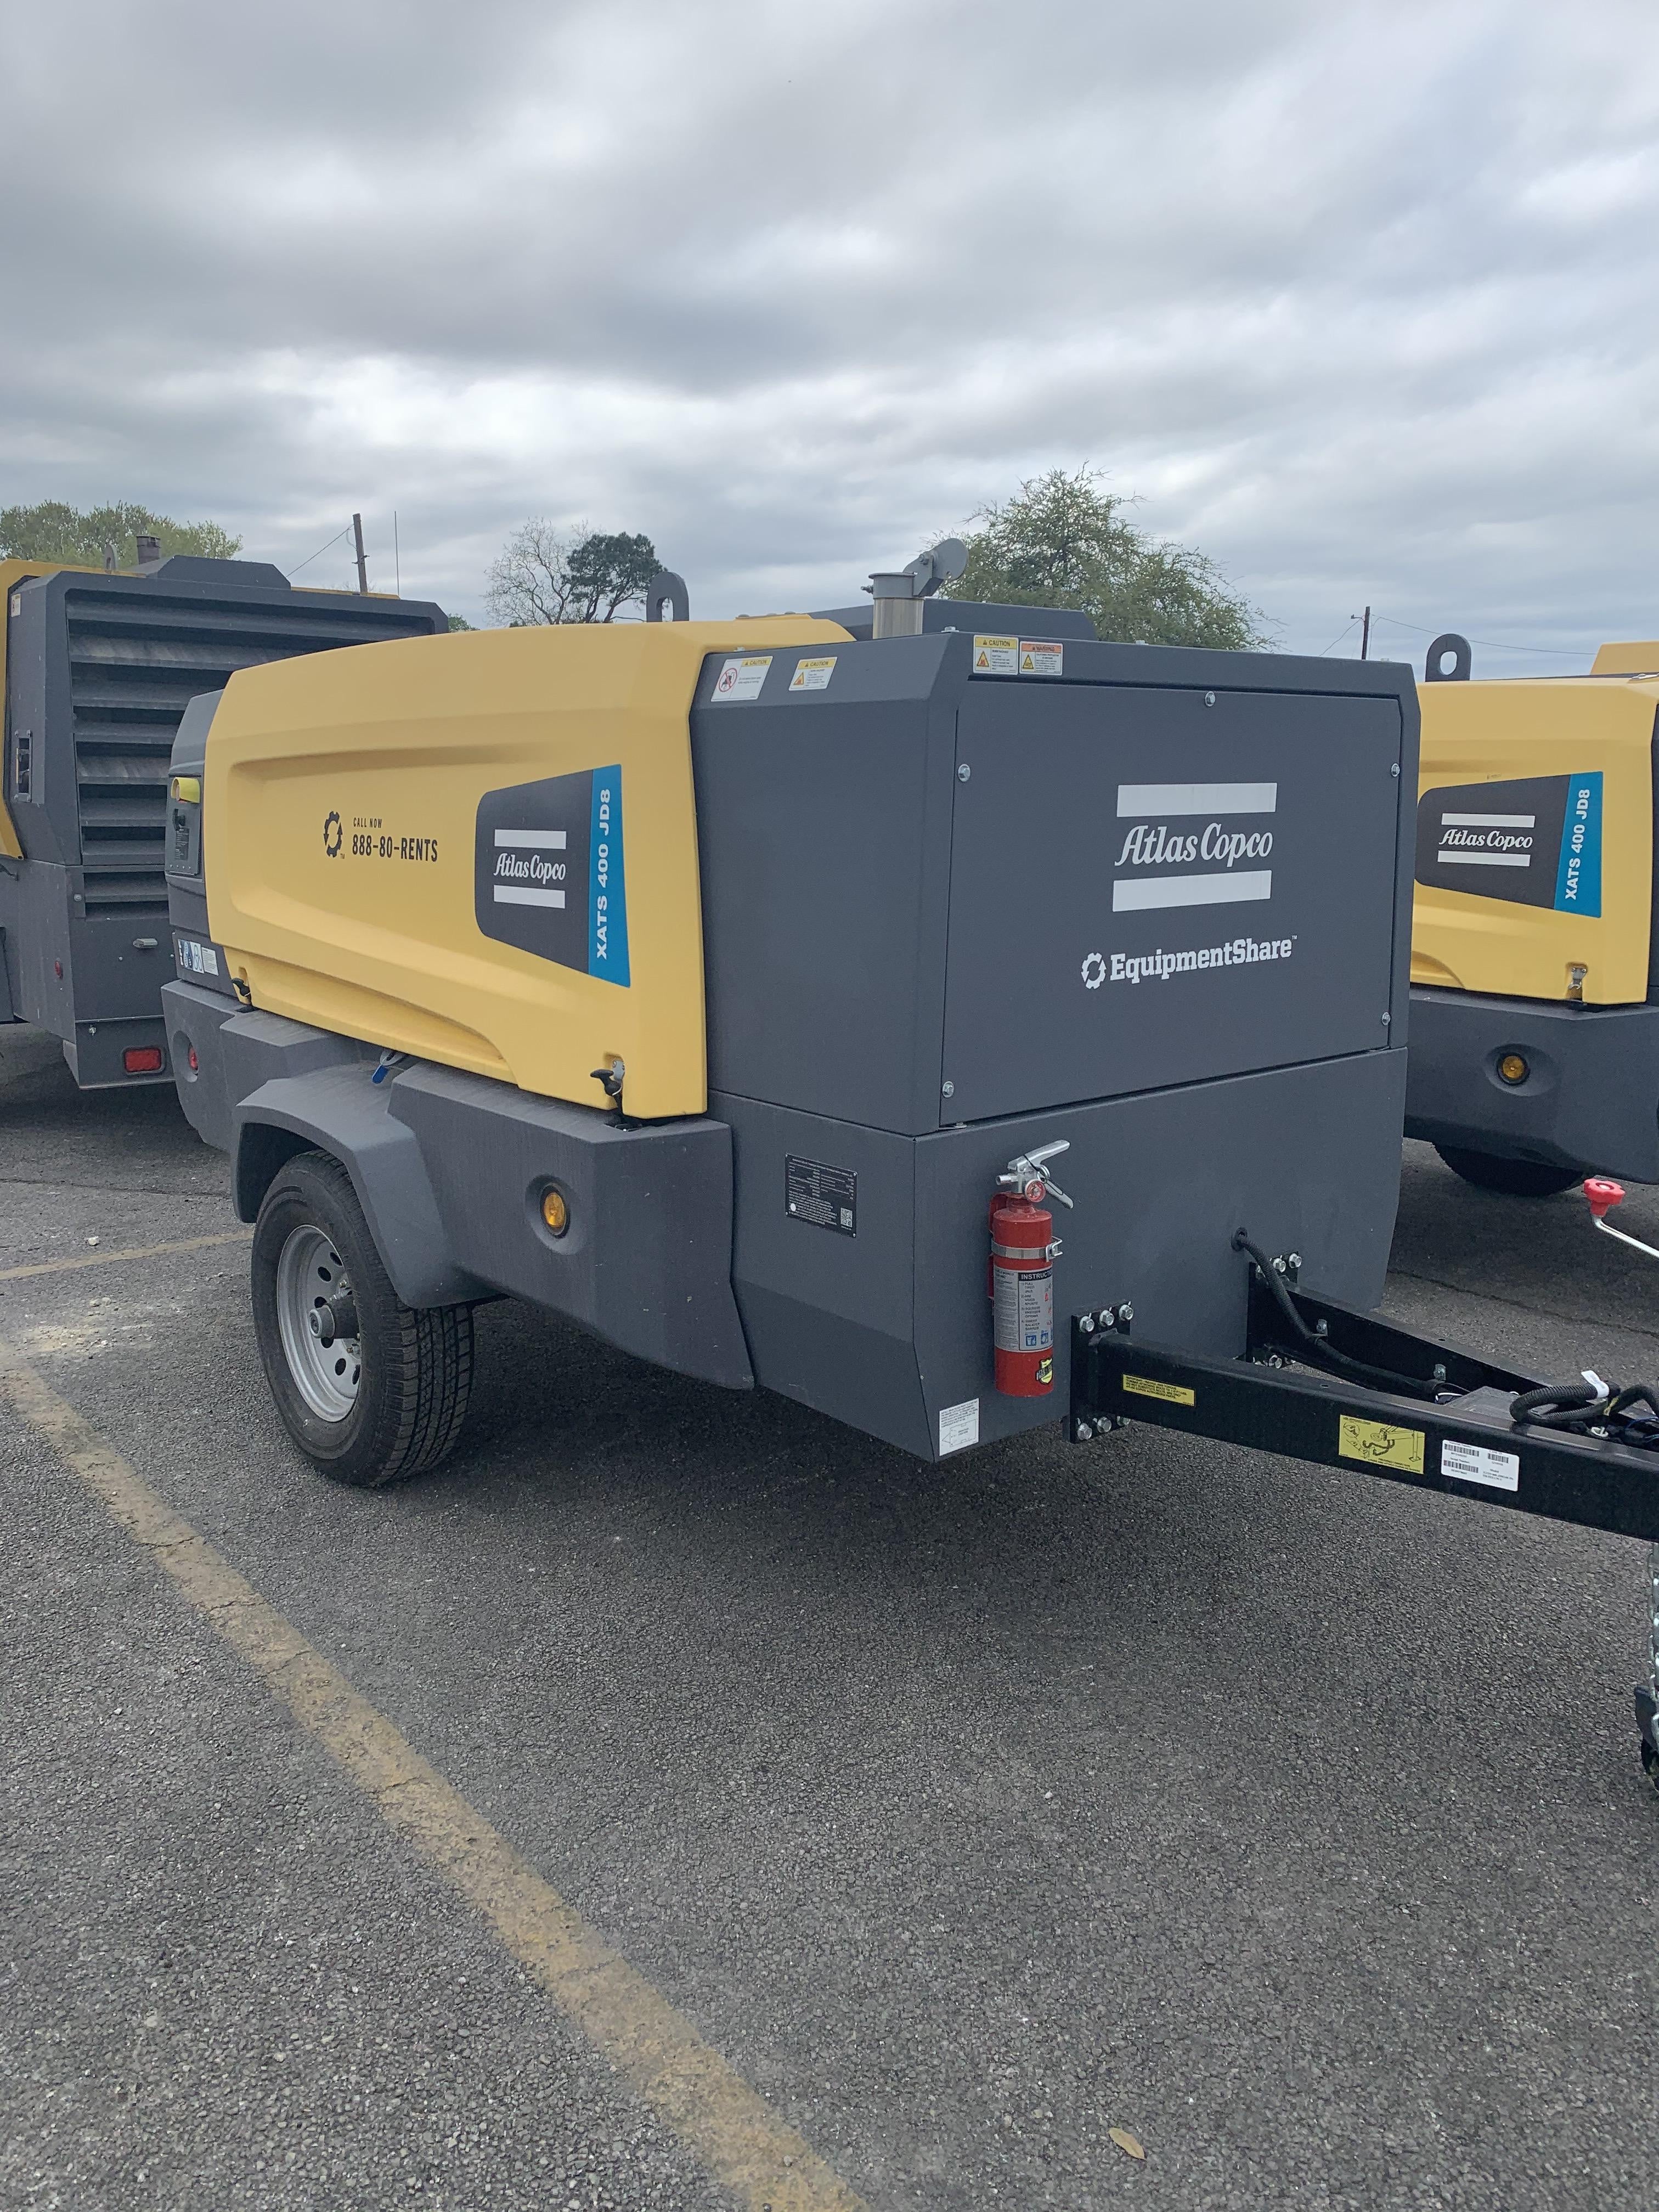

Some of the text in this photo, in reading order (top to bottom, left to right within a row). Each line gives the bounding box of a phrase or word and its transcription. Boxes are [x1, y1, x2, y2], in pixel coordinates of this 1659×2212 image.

[353, 817, 382, 828] CALL NOW
[1438, 829, 1533, 851] Atlas Copco
[352, 834, 438, 862] 888-80-RENTS
[1114, 822, 1273, 867] Atlas Copco
[1565, 789, 1590, 900] XATS 400 JD8
[494, 853, 566, 884] Atlas Copco
[596, 788, 610, 960] XATS 400 JD8
[1110, 938, 1292, 984] EquipmentShare
